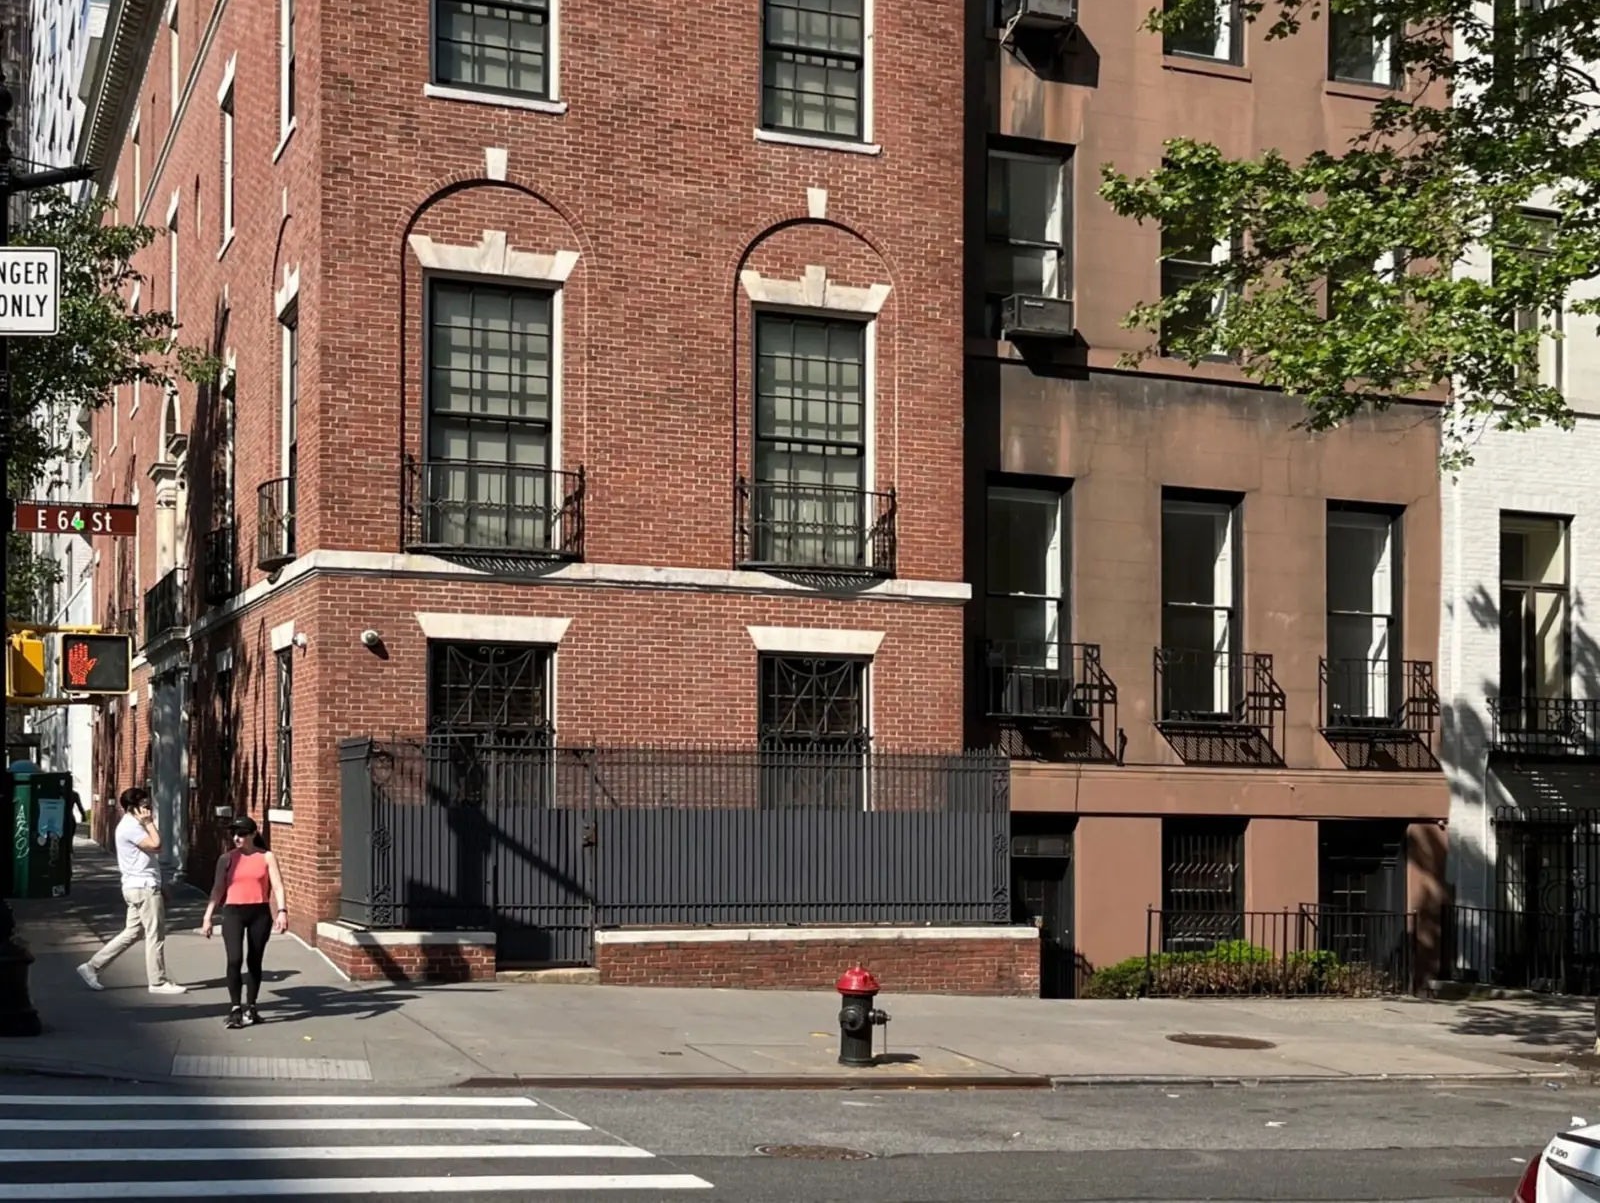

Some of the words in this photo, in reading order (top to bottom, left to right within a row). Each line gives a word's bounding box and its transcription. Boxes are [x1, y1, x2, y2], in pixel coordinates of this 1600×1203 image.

[0, 294, 48, 317] ONLY
[37, 510, 47, 529] E
[92, 512, 112, 532] St
